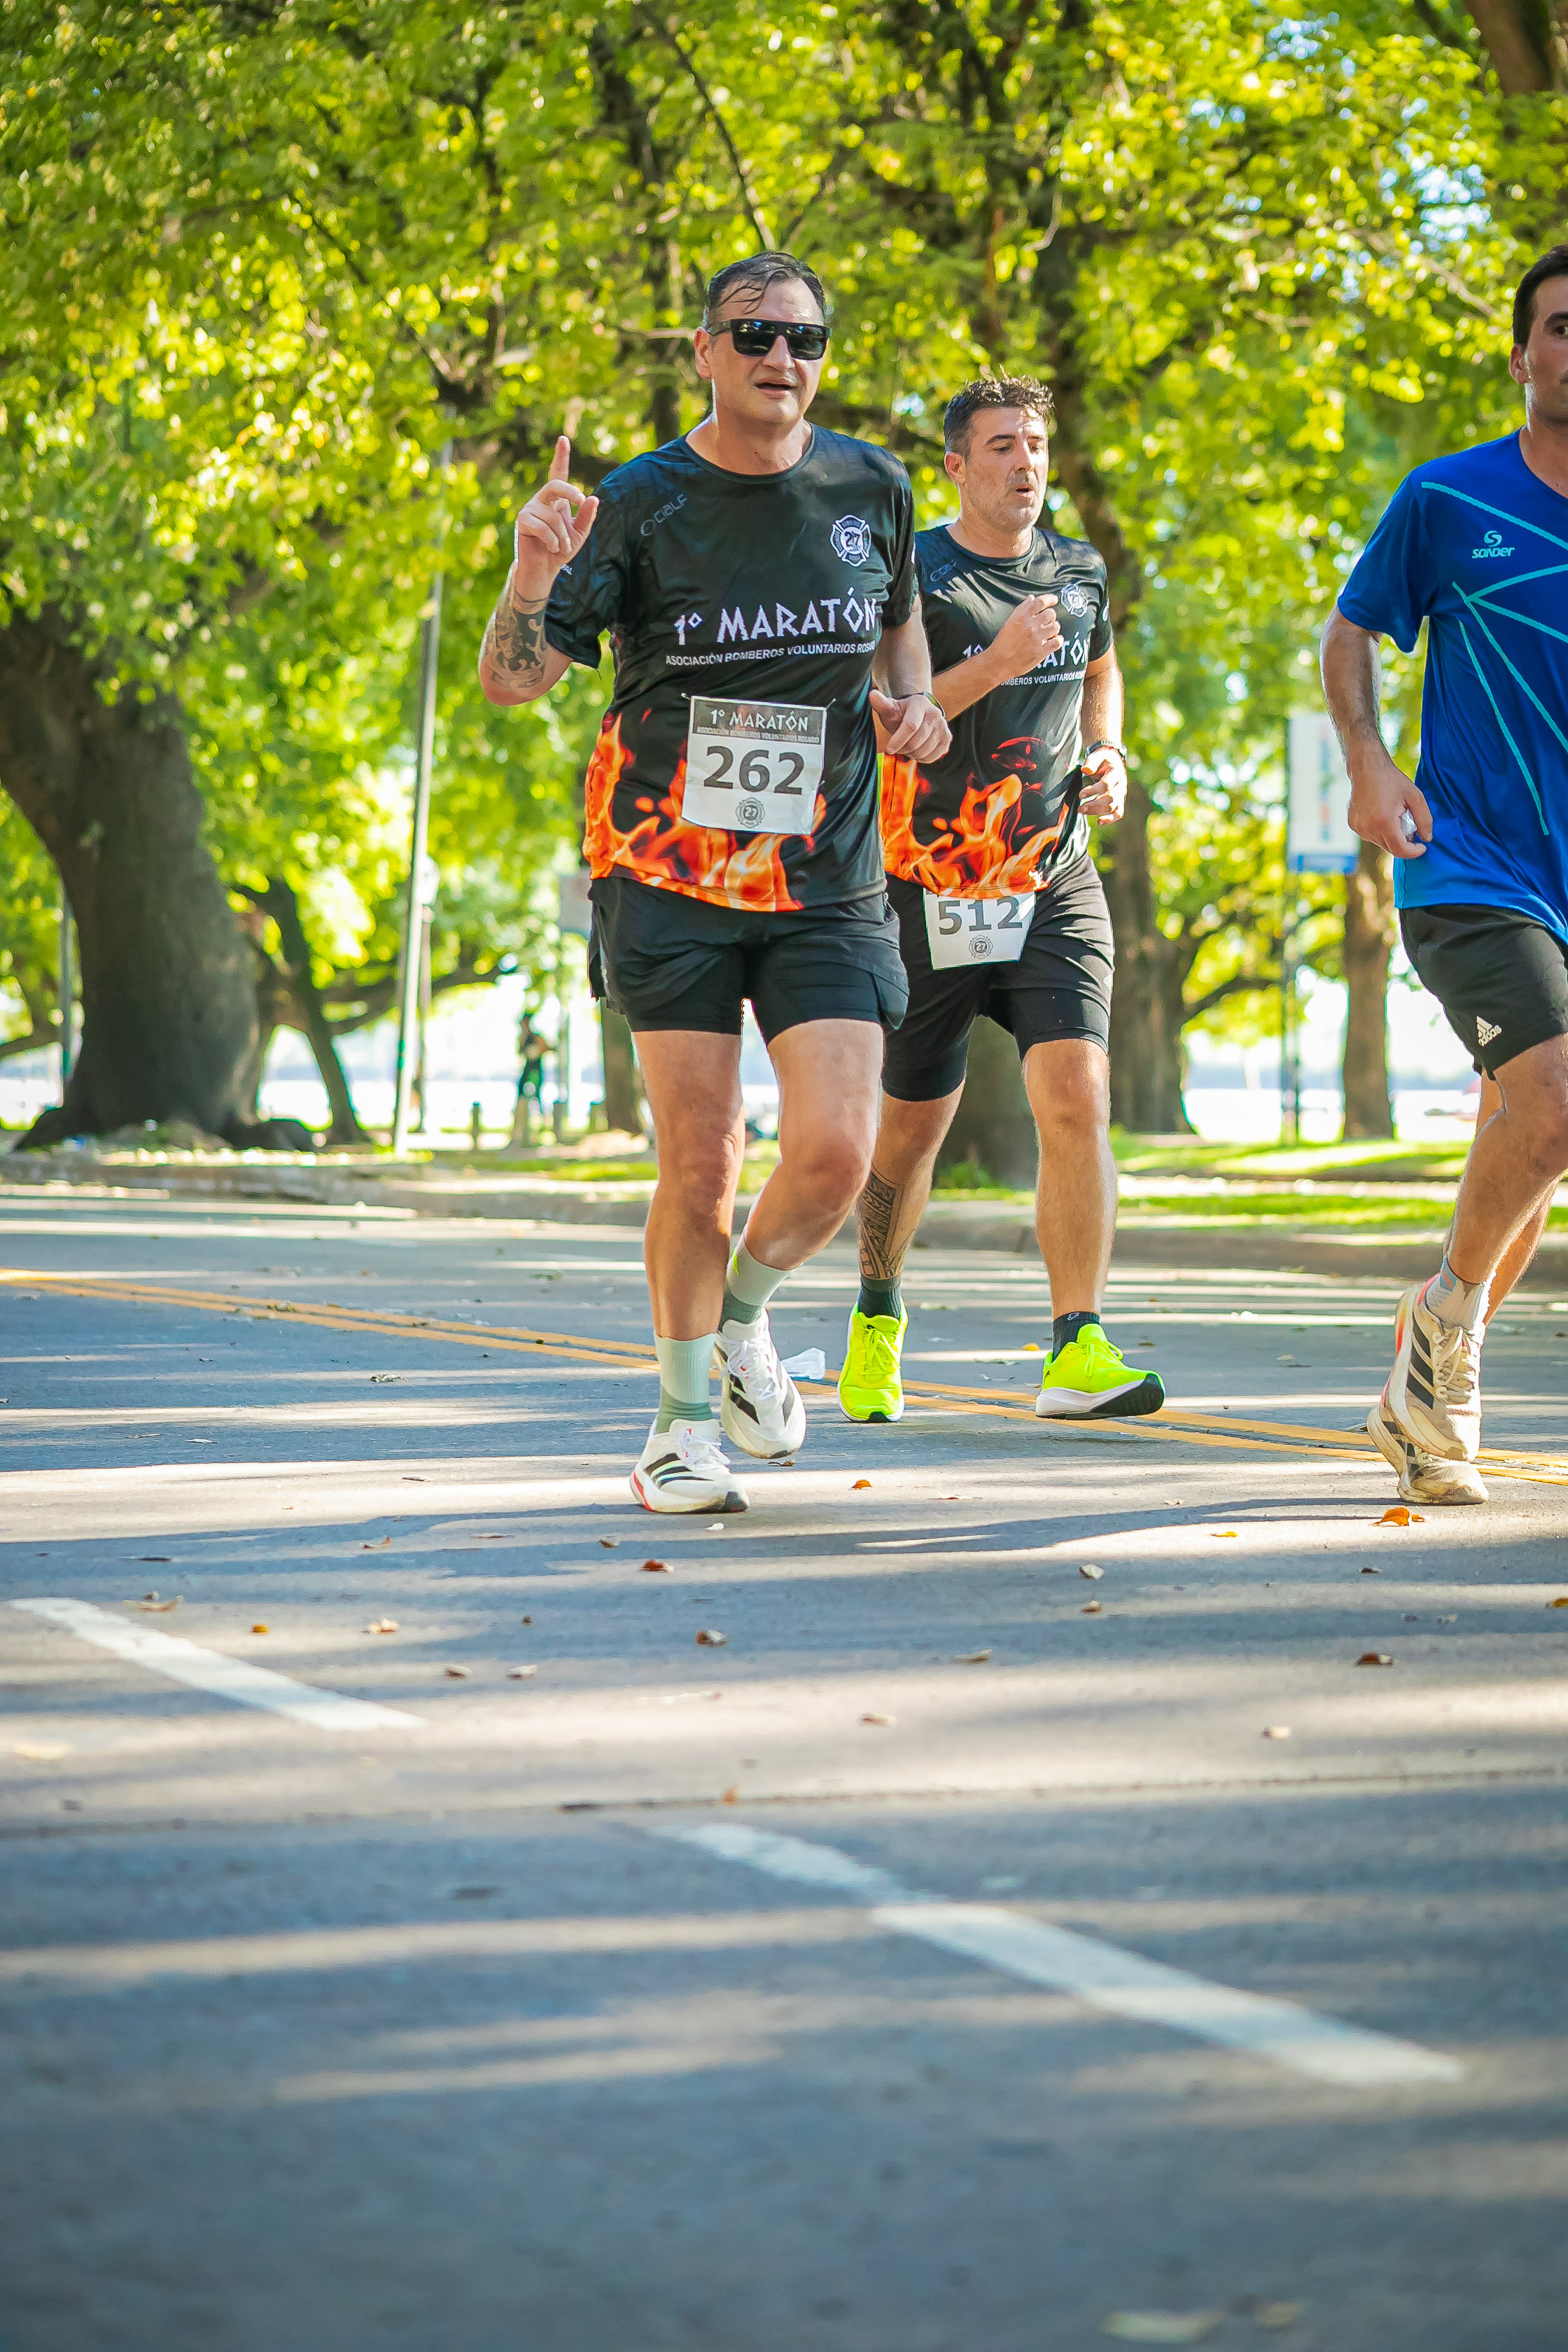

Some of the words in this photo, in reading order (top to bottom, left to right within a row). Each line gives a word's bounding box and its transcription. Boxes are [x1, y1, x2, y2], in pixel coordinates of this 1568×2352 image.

[717, 587, 877, 643] MARATÓN
[665, 652, 723, 666] ASOCIACIÓN
[724, 648, 785, 663] BOMBEROS
[788, 643, 856, 655] VOLUNTARIOS
[1001, 676, 1032, 686] OMBEROS
[1034, 671, 1075, 684] VOLUNTARIOS
[729, 710, 809, 732] MARATÓN
[704, 746, 804, 795] 262
[939, 896, 1023, 935] 512
[1478, 1024, 1502, 1047] adidas
